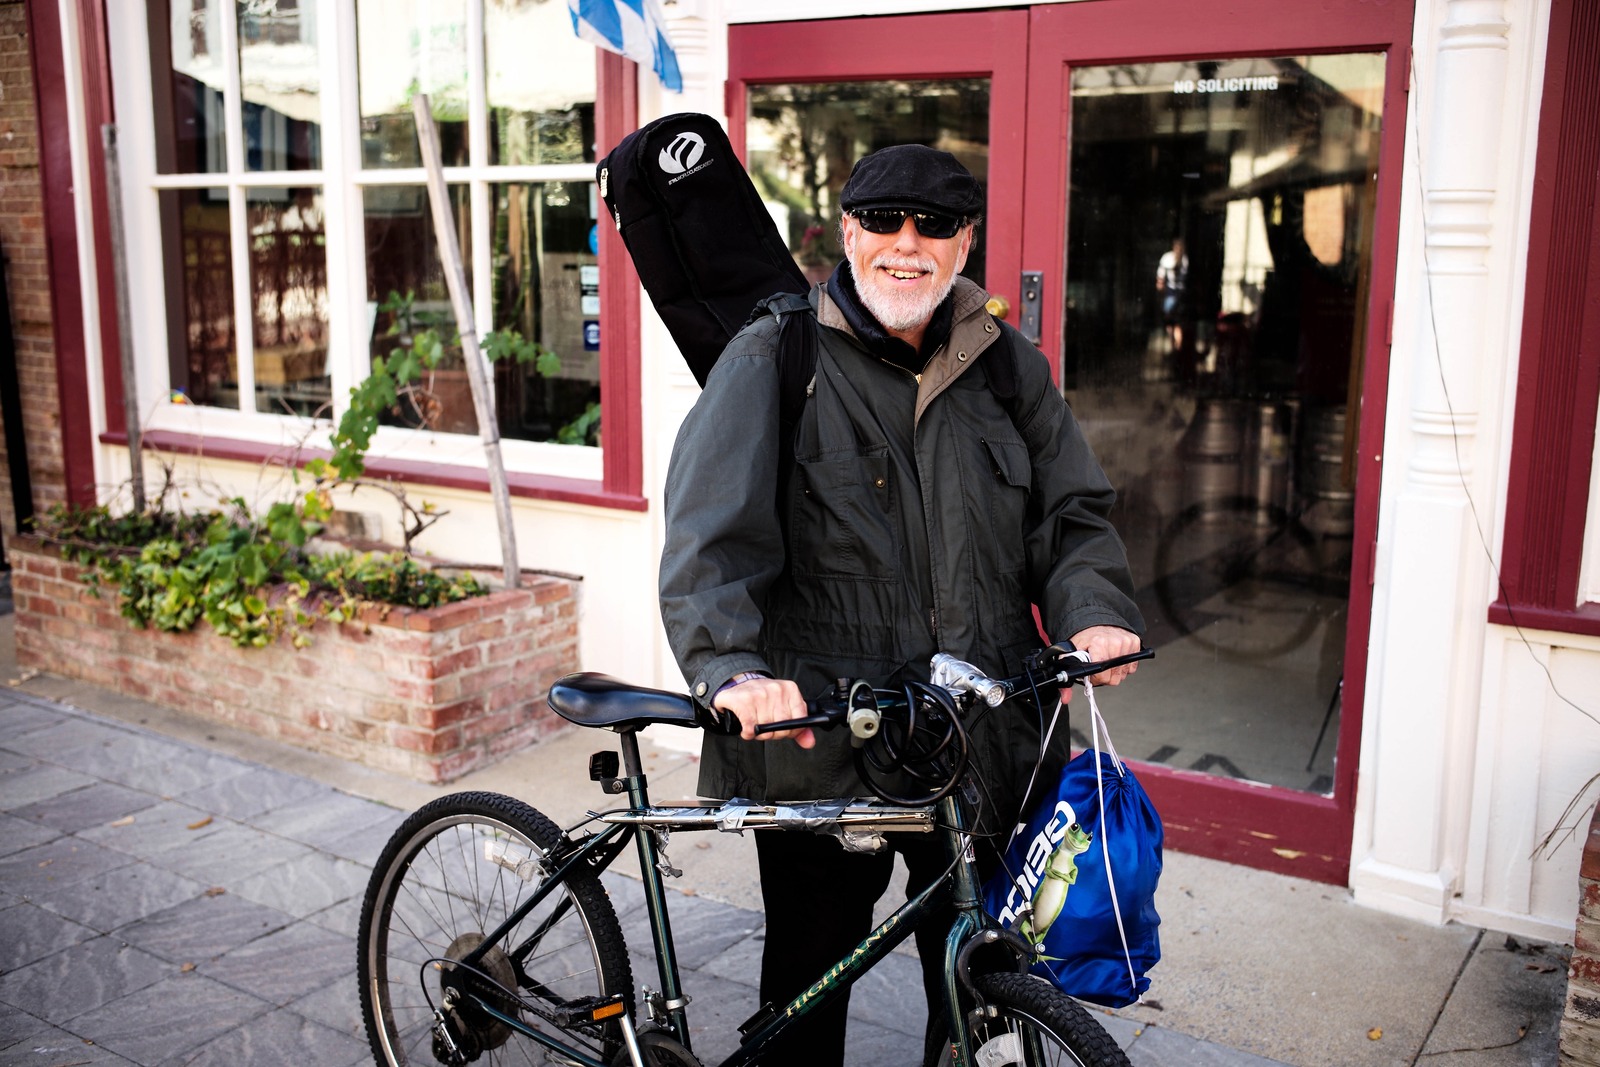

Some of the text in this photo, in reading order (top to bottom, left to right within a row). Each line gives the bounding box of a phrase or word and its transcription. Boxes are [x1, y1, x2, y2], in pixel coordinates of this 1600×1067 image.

[1173, 76, 1278, 93] NO SOLICITING
[786, 915, 898, 1018] HIGHLAND
